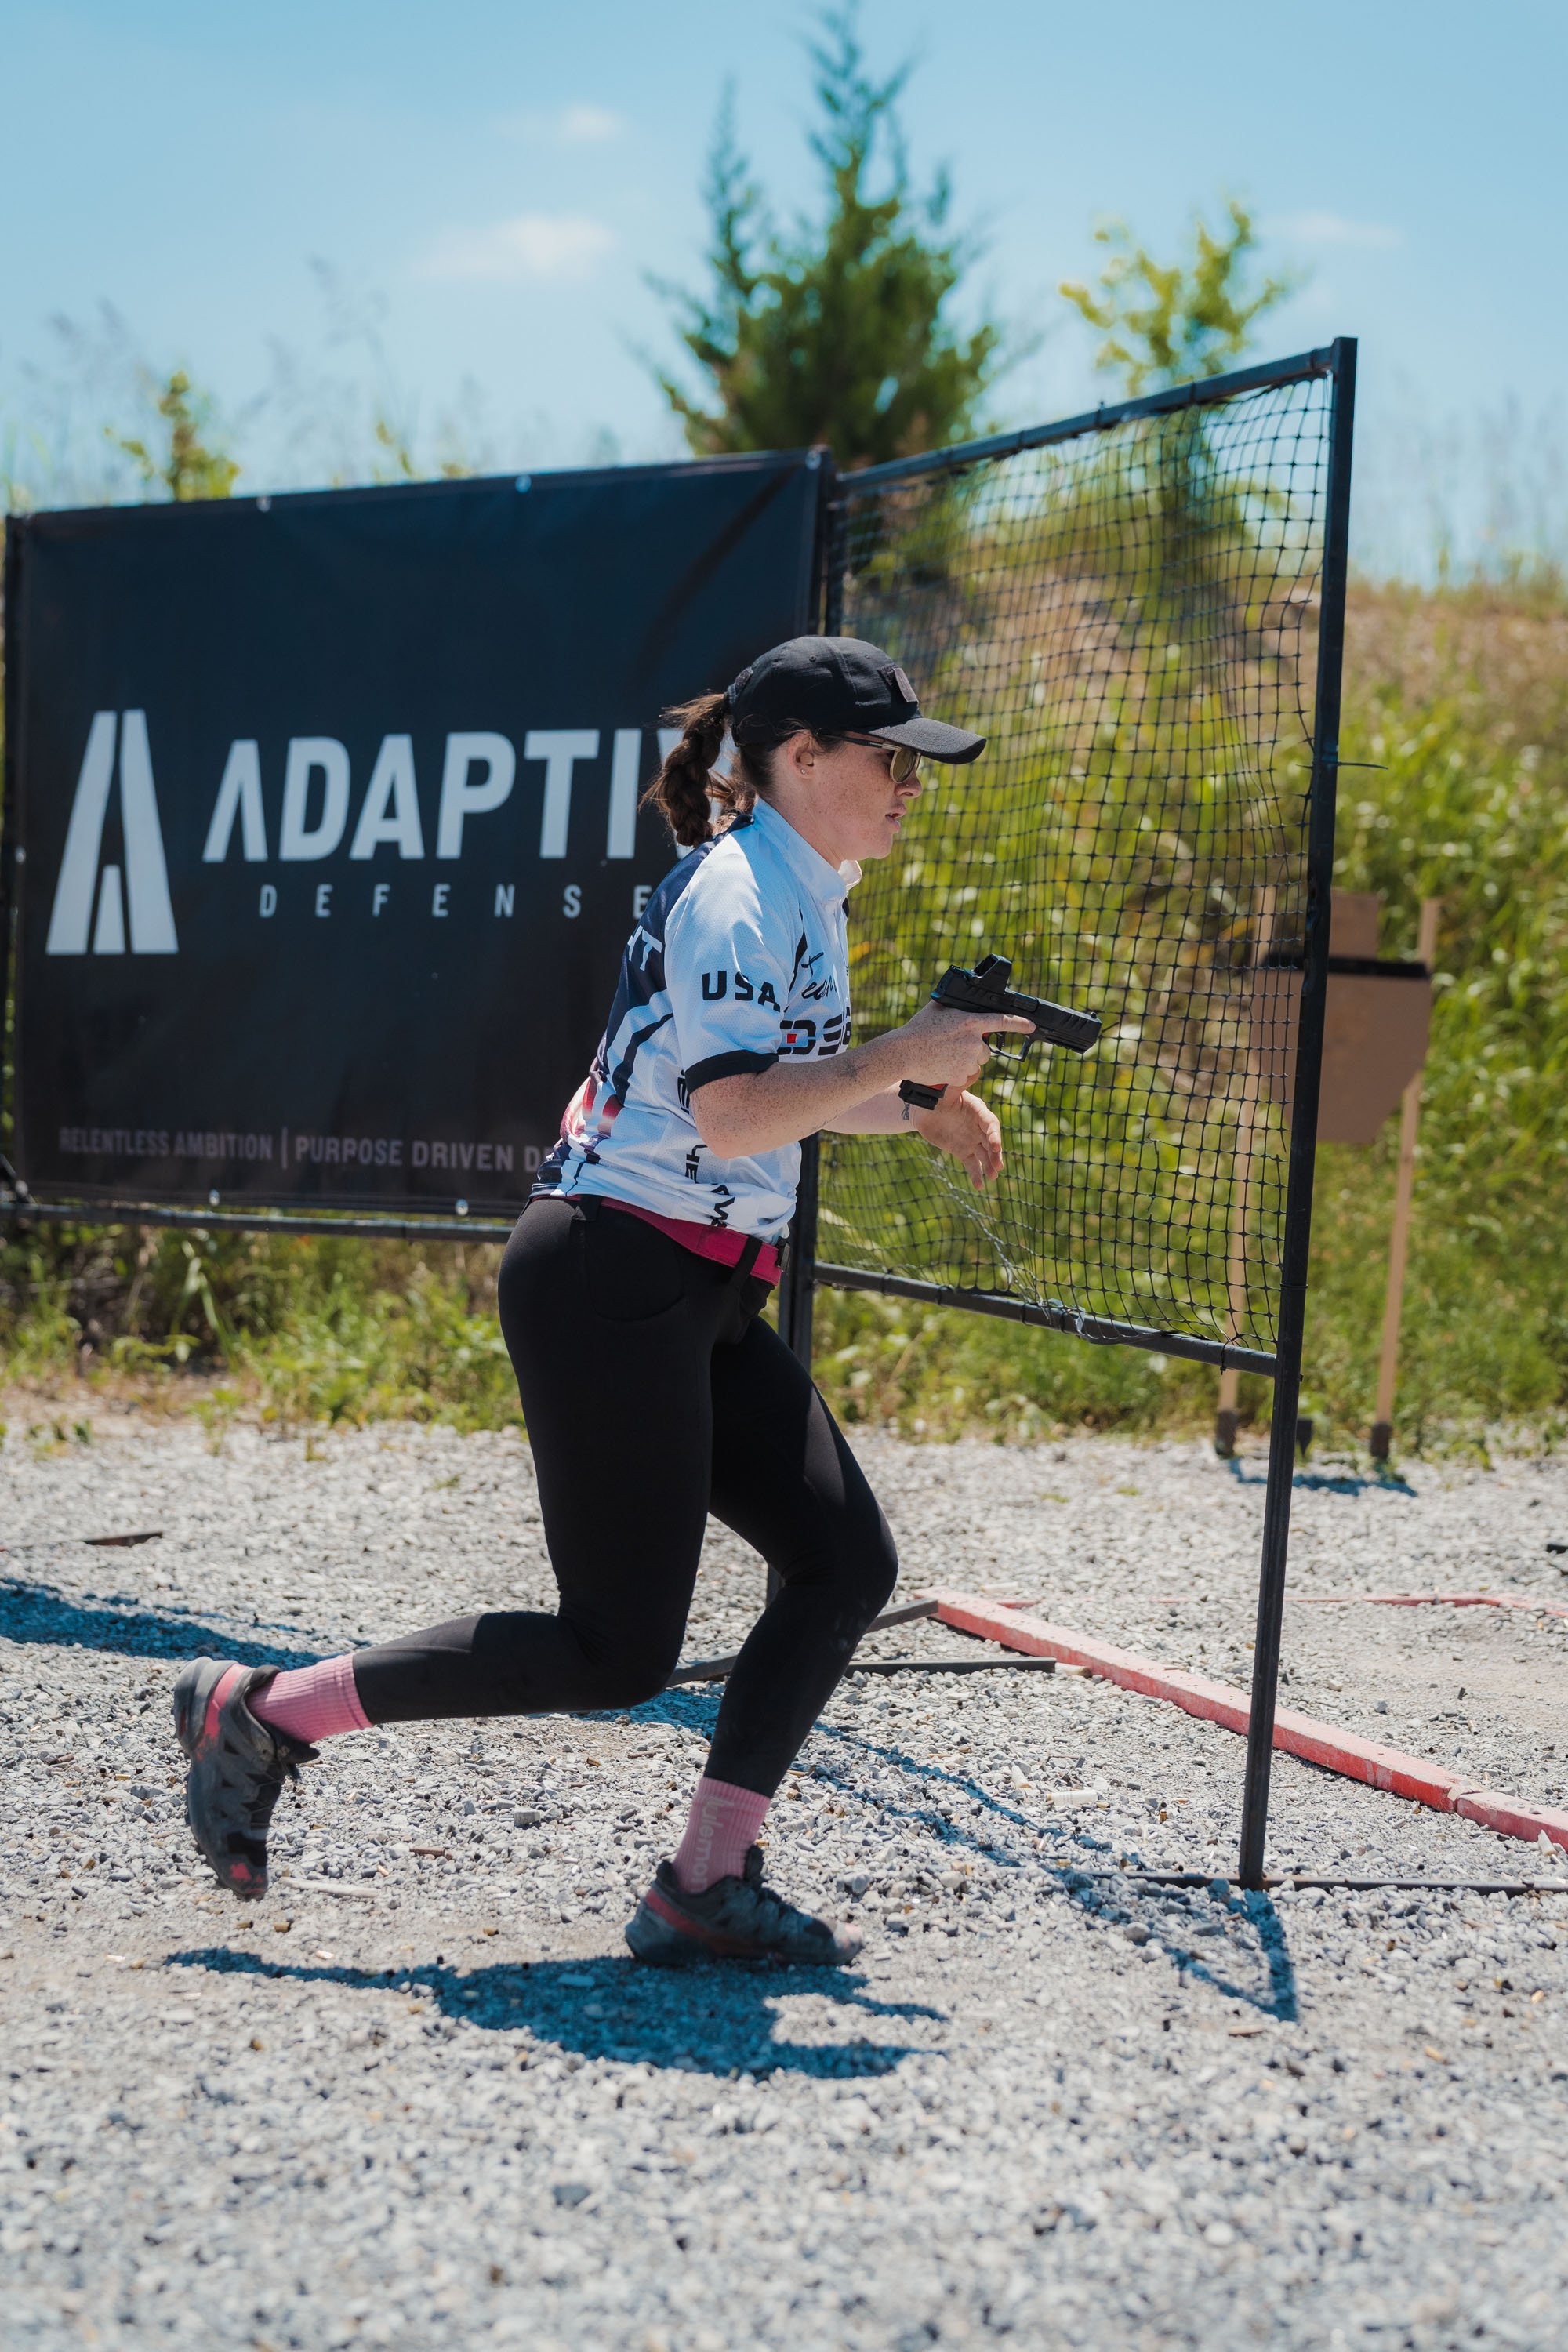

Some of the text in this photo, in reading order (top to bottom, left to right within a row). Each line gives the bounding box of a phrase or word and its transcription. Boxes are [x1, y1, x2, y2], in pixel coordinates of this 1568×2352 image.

[259, 884, 652, 919] DEFENSE
[701, 970, 782, 1013] USA
[58, 1127, 170, 1156] RELENTLESS
[172, 1131, 273, 1160] AMBITION
[295, 1134, 404, 1167] PURPOSE
[412, 1140, 514, 1171] DRIVEN
